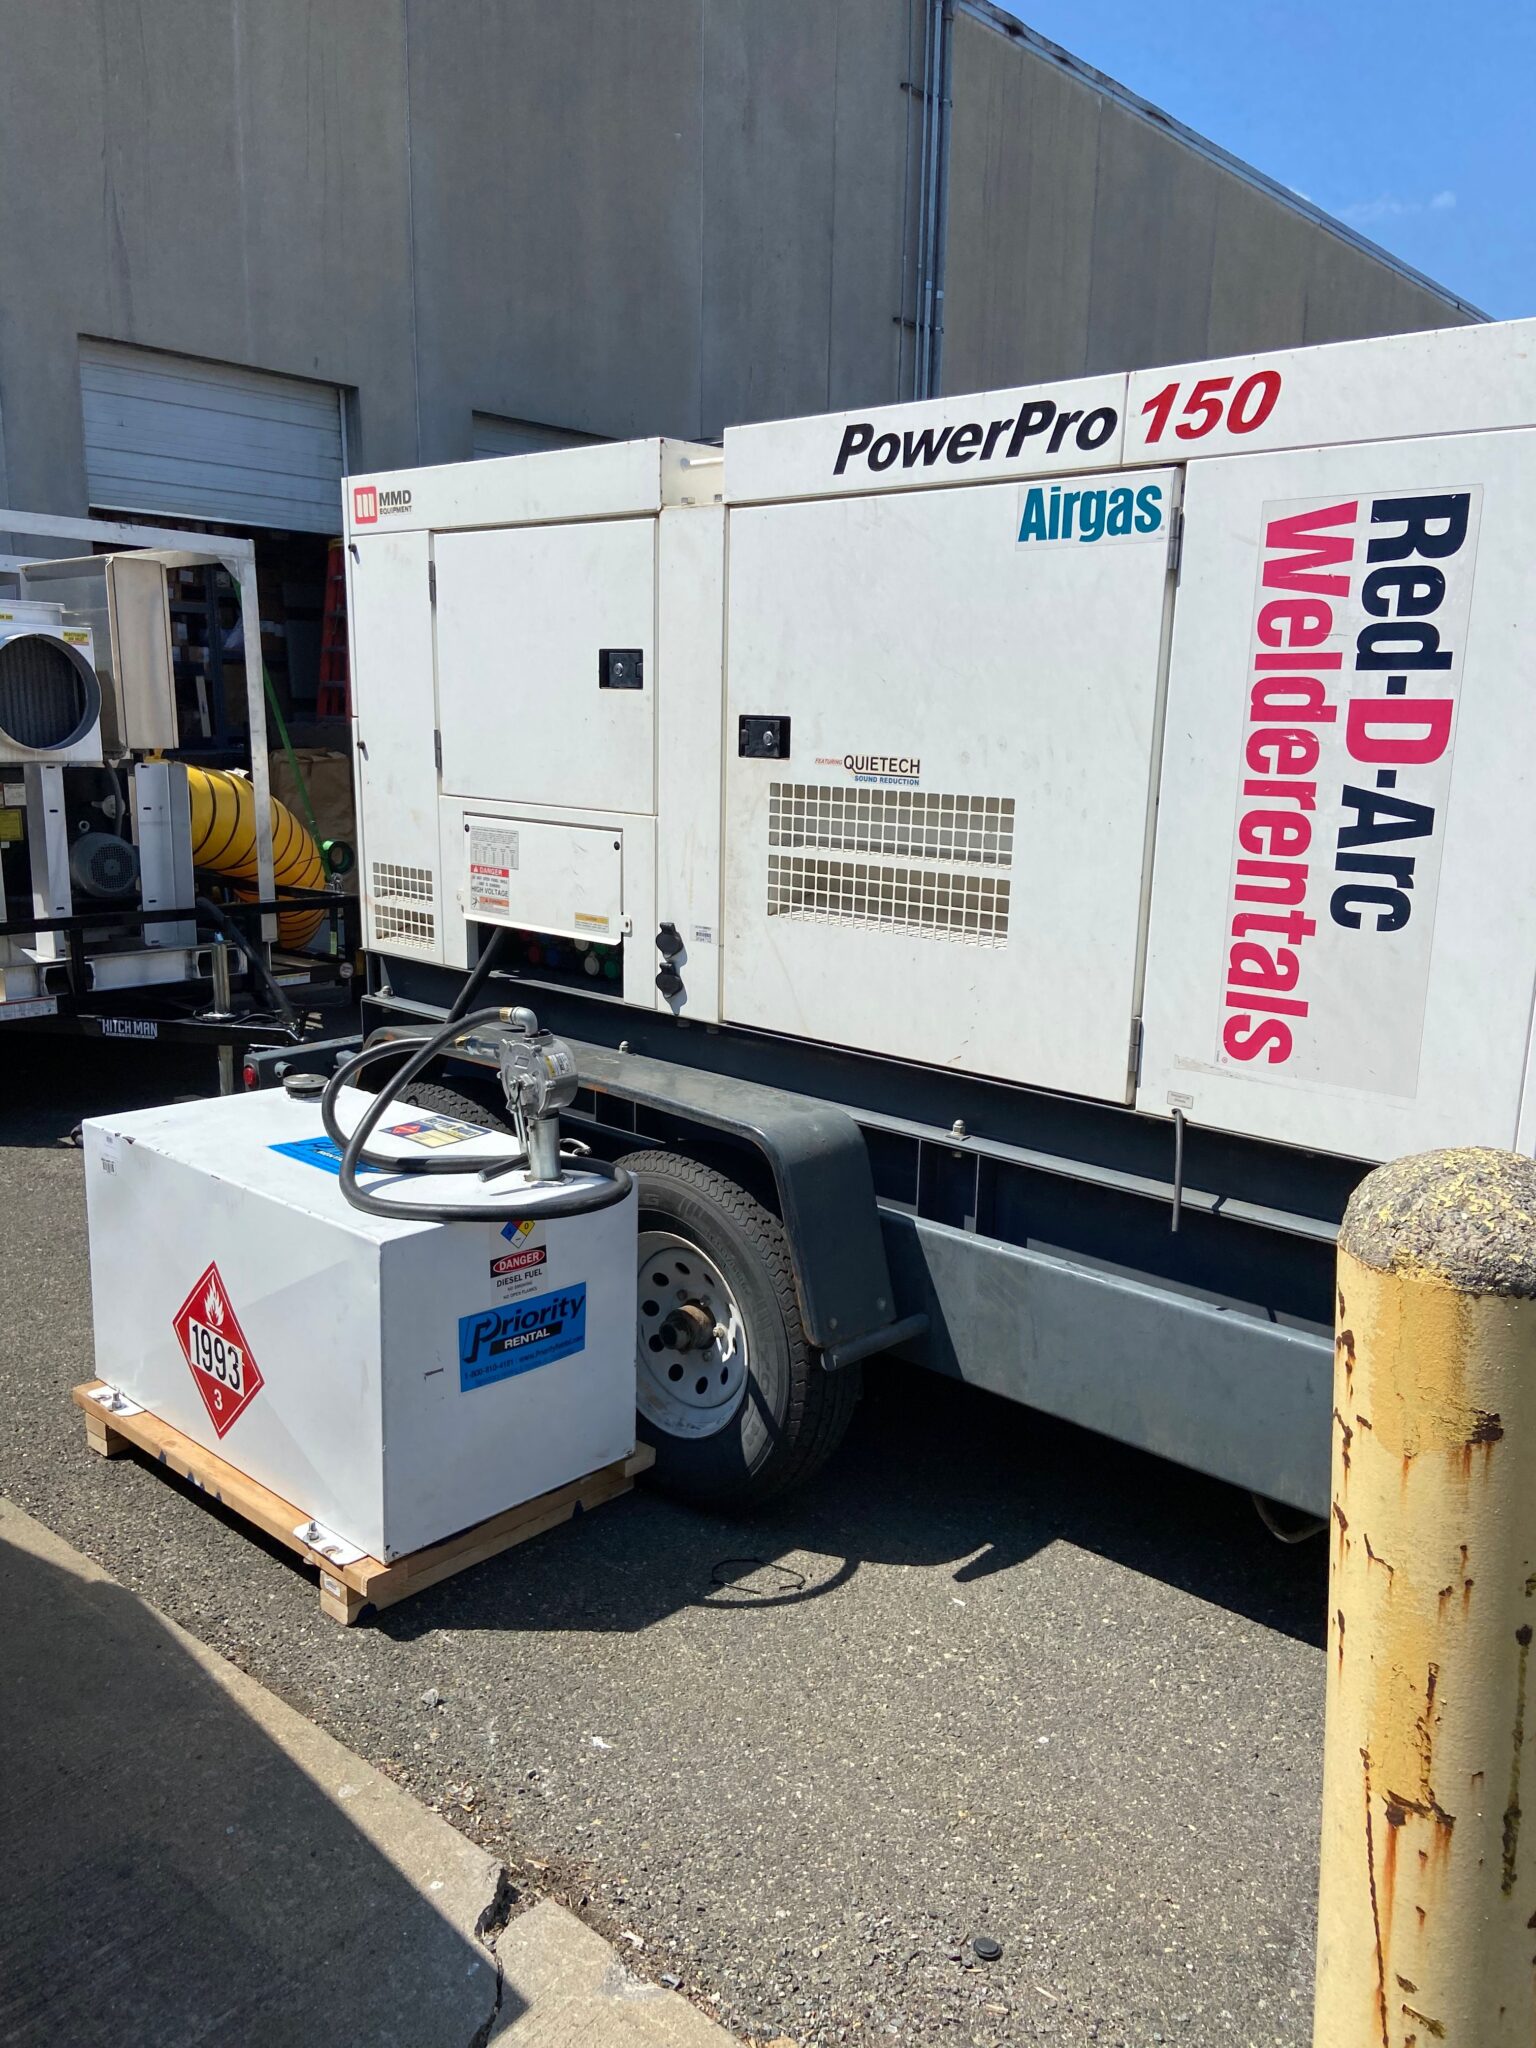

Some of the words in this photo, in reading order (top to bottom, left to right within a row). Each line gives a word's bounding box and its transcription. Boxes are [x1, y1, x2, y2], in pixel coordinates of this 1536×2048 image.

[833, 399, 1118, 476] PowerPro
[1141, 370, 1282, 445] 150
[379, 490, 411, 506] MMD
[380, 505, 412, 515] EQUIPMENT
[1018, 484, 1162, 543] Airgas
[1328, 492, 1471, 932] Red-D-Arc
[815, 757, 843, 766] FEATURING
[844, 755, 920, 774] QUIETECH
[854, 775, 878, 783] SOUND
[880, 776, 920, 786] REDUCTION
[1222, 499, 1358, 1065] Welderentals
[480, 866, 502, 876] DANGER
[102, 1019, 131, 1034] HITCH
[133, 1021, 158, 1037] MAN
[499, 1252, 540, 1271] DANGER
[496, 1274, 523, 1288] DIESEL
[524, 1268, 543, 1280] FUEL
[463, 1294, 586, 1364] Priority
[504, 1328, 551, 1350] RENTAL
[192, 1323, 241, 1391] 1993
[213, 1388, 223, 1411] 3
